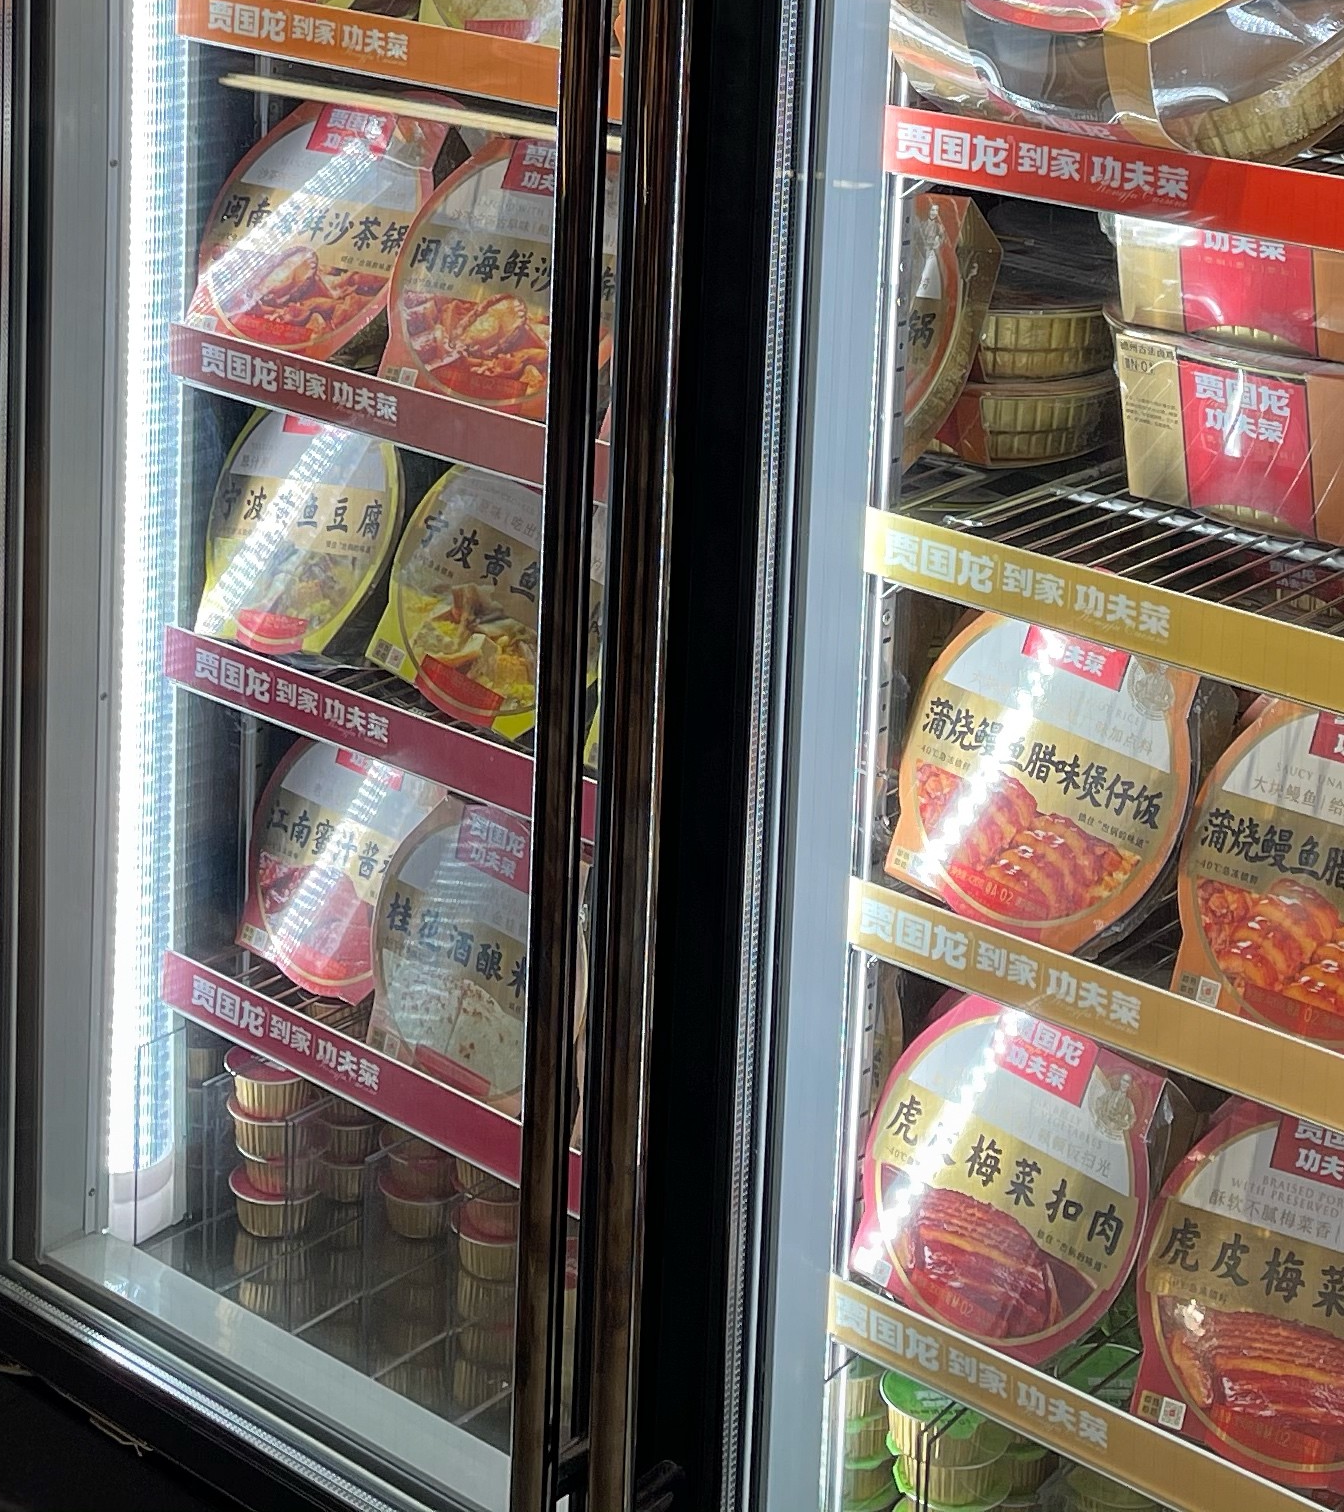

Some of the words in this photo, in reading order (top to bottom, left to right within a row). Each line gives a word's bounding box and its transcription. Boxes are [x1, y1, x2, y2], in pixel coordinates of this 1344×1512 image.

[208, 0, 286, 43] 贾国龙
[292, 15, 336, 45] 到家
[341, 26, 409, 62] 功夫菜
[896, 122, 1009, 176] 贾国龙
[1017, 141, 1081, 180] 到家
[1090, 155, 1190, 202] 功夫菜
[201, 342, 278, 392] 贾国龙
[283, 365, 327, 400] 到家
[332, 381, 398, 421] 功夫菜
[882, 528, 995, 594] 贾国龙
[1002, 561, 1065, 607] 到家
[1074, 583, 1170, 638] 功夫菜
[195, 648, 271, 703] 贾国龙
[276, 679, 319, 716] 到家
[324, 696, 390, 744] 功夫菜
[1276, 762, 1312, 781] SAUCY
[860, 898, 969, 971] 贾国龙
[975, 943, 1039, 989] 到家
[1047, 966, 1142, 1029] 功夫菜
[191, 974, 264, 1038] 贾国龙
[269, 1015, 312, 1056] 到家
[316, 1038, 381, 1091] 功夫菜
[1007, 1045, 1069, 1090] 功夫菜
[1262, 1175, 1315, 1197] BRAISED
[1270, 1190, 1341, 1219] PRESERVED
[835, 1294, 940, 1371] 贾国龙
[946, 1347, 1006, 1399] 到家
[1016, 1380, 1109, 1447] 功夫菜
